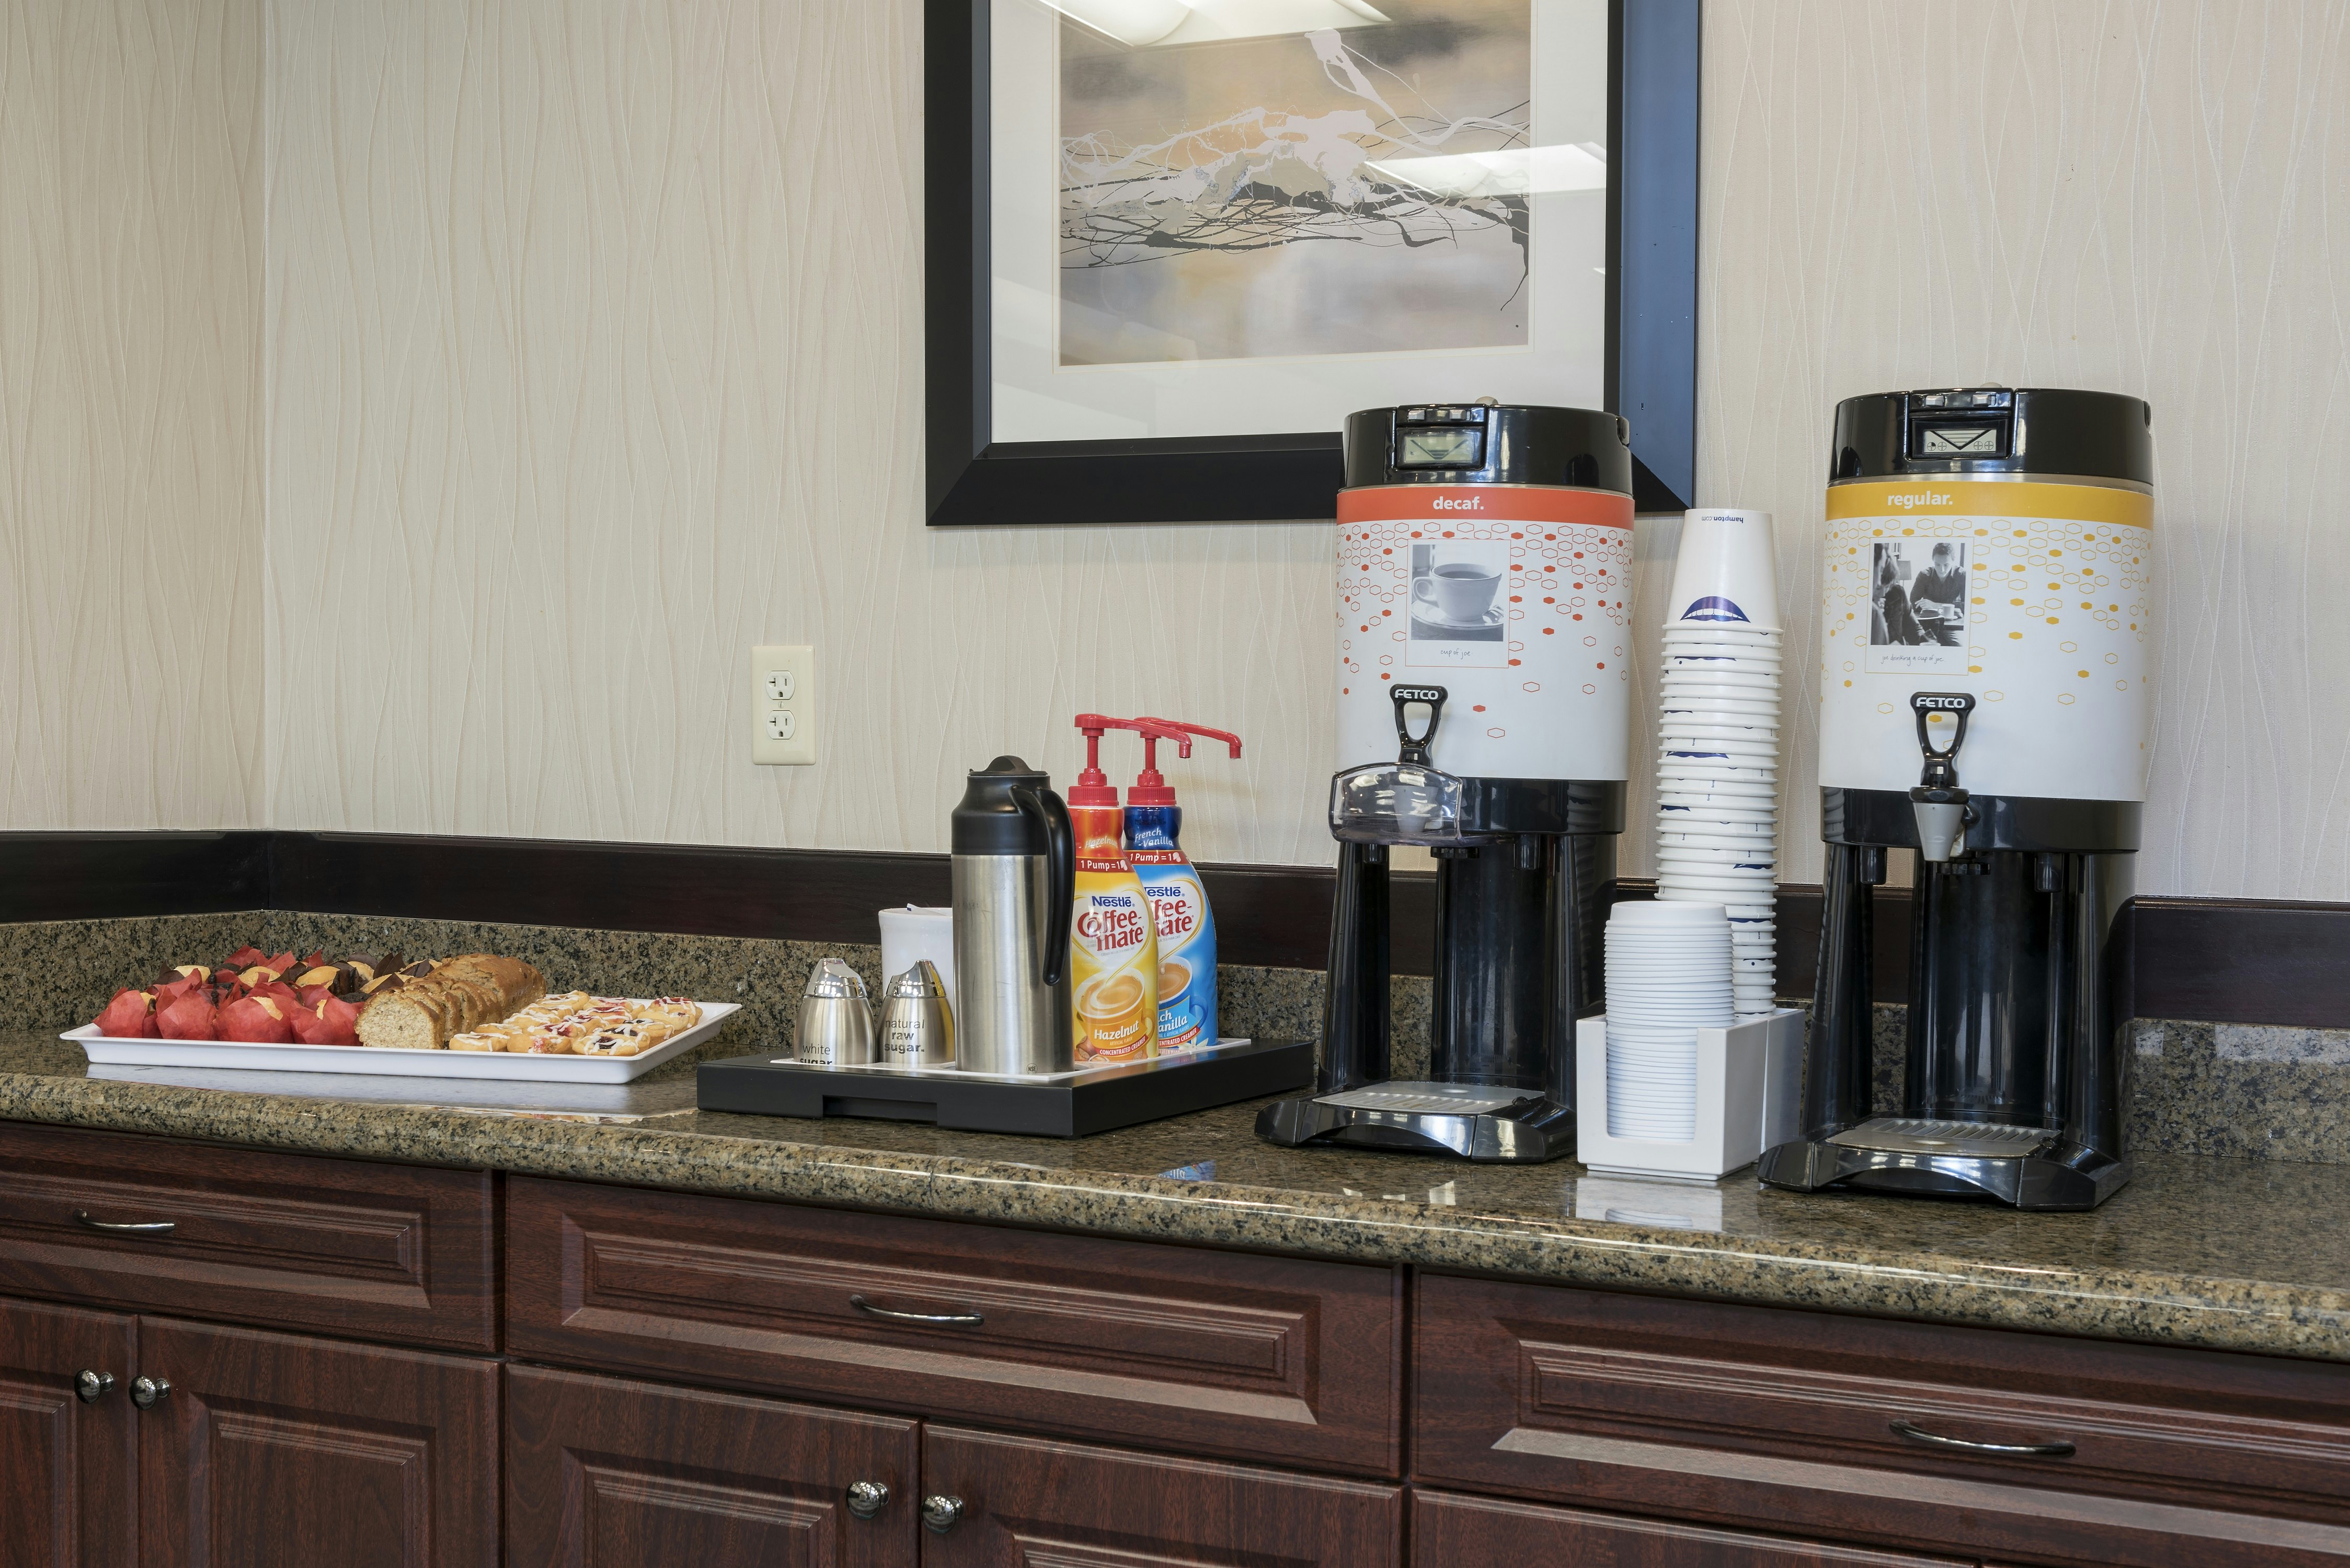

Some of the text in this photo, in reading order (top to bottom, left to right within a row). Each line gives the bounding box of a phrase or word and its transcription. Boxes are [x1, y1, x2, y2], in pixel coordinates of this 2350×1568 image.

[1433, 496, 1484, 510] decaf.
[1888, 490, 1953, 509] regular.
[1890, 653, 1911, 666] drinking
[1395, 689, 1439, 700] FETCO
[1916, 697, 1966, 708] FETCO
[1134, 827, 1162, 843] French
[1143, 836, 1174, 847] Vanilla
[1084, 835, 1118, 849] Hazelnut
[1130, 853, 1133, 861] 1
[1135, 853, 1159, 863] Pump
[1081, 860, 1084, 869] 1
[1087, 860, 1110, 871] Pump
[1097, 927, 1143, 951] mate
[885, 1019, 925, 1029] natural
[1094, 1020, 1139, 1040] Hazelnut
[1159, 1016, 1187, 1032] anilla
[892, 1031, 914, 1040] raw
[1159, 1028, 1197, 1046] ENTRATED CREAMER
[803, 1043, 831, 1055] white
[884, 1043, 925, 1054] sugar.
[1099, 1036, 1145, 1055] CONCENTRATED CREAMER
